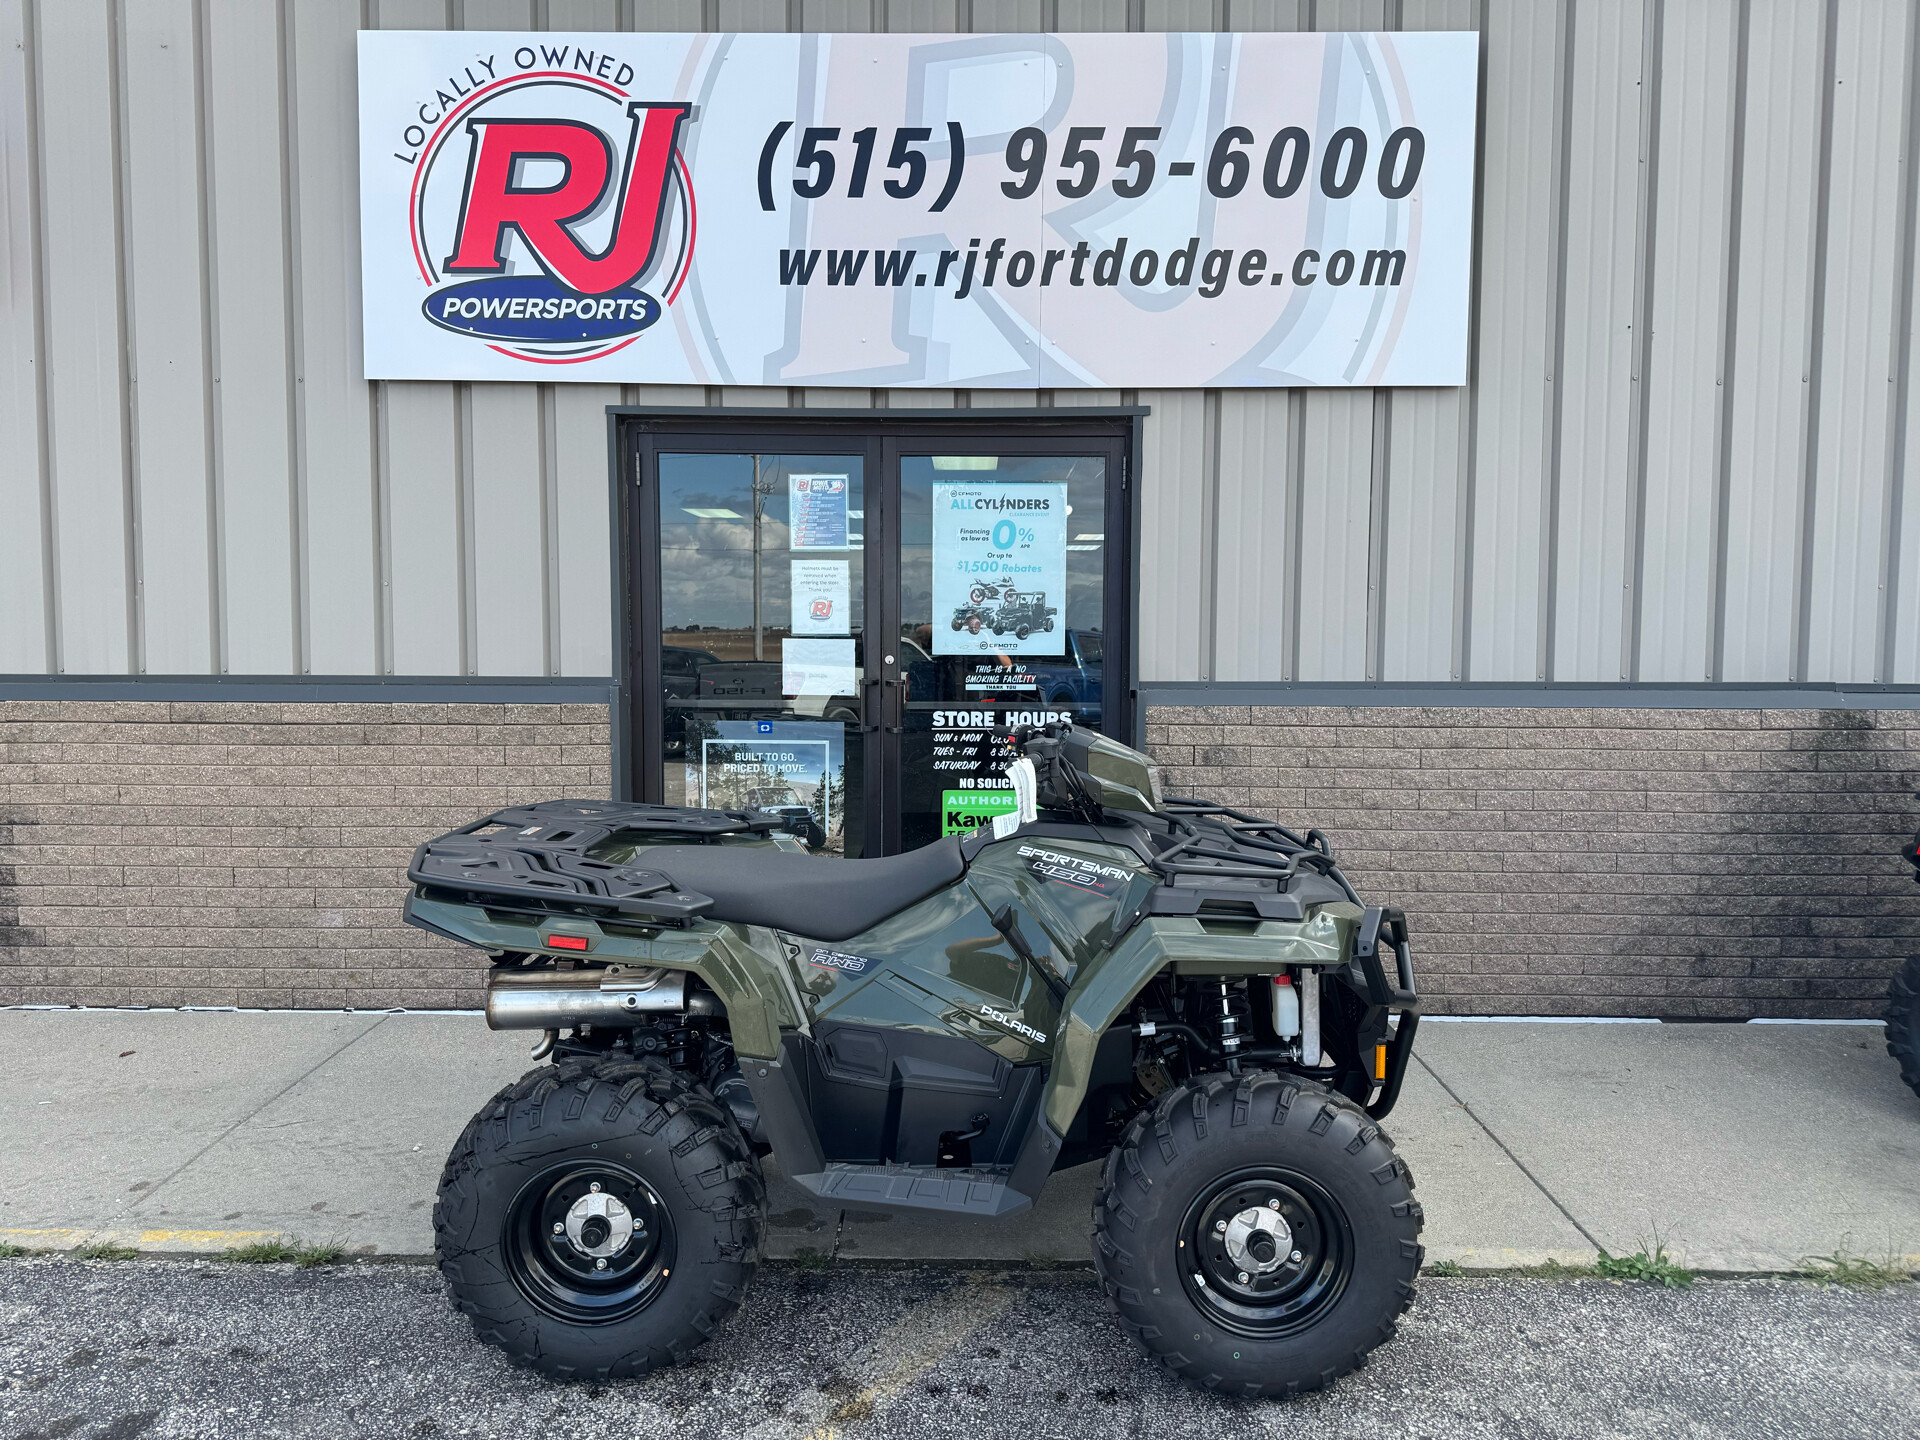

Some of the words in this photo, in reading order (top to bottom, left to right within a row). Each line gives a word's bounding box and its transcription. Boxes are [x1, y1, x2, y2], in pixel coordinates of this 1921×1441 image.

[394, 54, 496, 165] LOCALLY
[514, 44, 635, 87] OWNED
[758, 121, 967, 212] (515)
[1000, 126, 1426, 200] 955-6000
[442, 101, 692, 295] RJ
[779, 237, 1407, 299] www.rjfortdodge.com
[442, 297, 647, 321] POWERSPORTS
[960, 528, 990, 536] Financing
[996, 553, 1005, 561] up
[957, 561, 999, 574] $1,500
[1001, 564, 1042, 573] Rebates
[975, 665, 993, 673] THIS
[994, 665, 1003, 673] IS
[1007, 665, 1013, 673] A
[1015, 665, 1027, 673] NO
[965, 674, 1000, 683] SMOKING
[1002, 674, 1037, 683] FACILITY
[932, 711, 995, 727] STORE
[933, 733, 953, 742] SUN
[961, 733, 983, 742] MON
[734, 752, 764, 762] BUILT
[764, 752, 780, 762] TO
[780, 752, 797, 762] GO.
[932, 747, 954, 756] TUES
[961, 747, 978, 756] FRI
[723, 763, 761, 773] PRICED
[761, 763, 776, 773] TO
[776, 763, 808, 773] MOVE.
[933, 761, 981, 770] SATURDAY
[959, 778, 975, 788] NO
[976, 778, 1014, 788] SOLICI
[947, 796, 1017, 805] AUTHORI
[1017, 845, 1134, 882] SPORTSMAN
[1032, 861, 1098, 886] 450
[810, 952, 865, 972] AWD
[980, 1004, 1047, 1044] POLARIS
